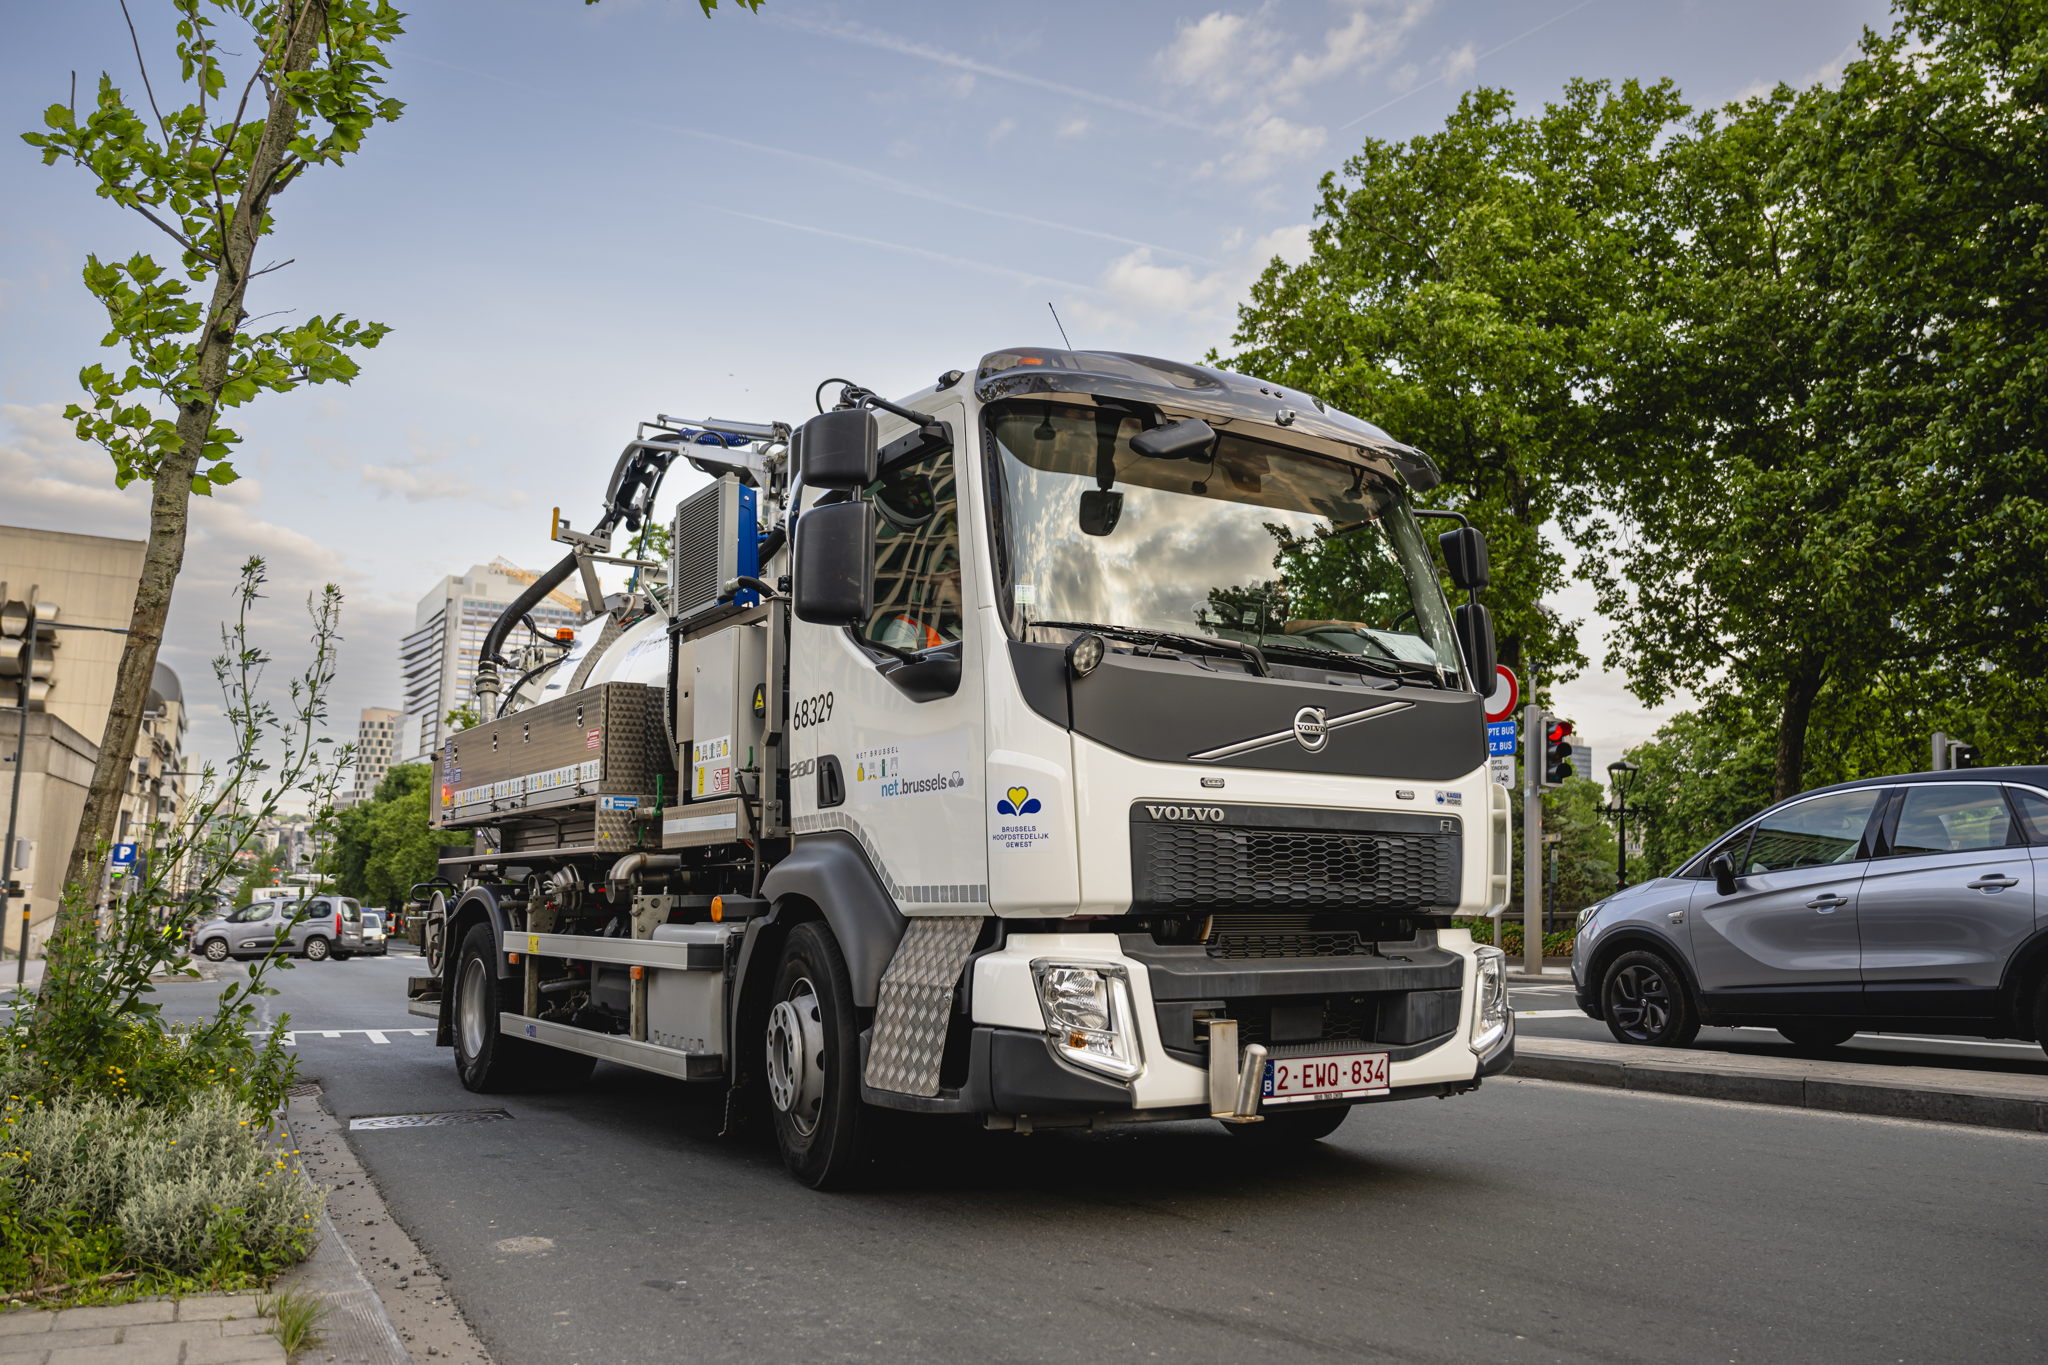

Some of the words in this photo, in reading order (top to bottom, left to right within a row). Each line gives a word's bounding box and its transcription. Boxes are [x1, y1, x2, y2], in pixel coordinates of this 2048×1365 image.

[793, 691, 834, 731] 68329
[1296, 724, 1326, 733] VOLVO
[1501, 726, 1515, 736] BUS
[870, 746, 899, 758] BRUSSEL
[1499, 741, 1513, 751] BUS
[790, 758, 816, 780] 280
[881, 773, 948, 797] net.brussels
[1145, 805, 1225, 822] VOLVO
[1001, 825, 1037, 833] BRUSSELS
[1440, 820, 1458, 833] FL
[992, 833, 1049, 841] HOOFDSTEDELIJK
[119, 846, 132, 860] P
[1277, 1059, 1385, 1091] 2-EWQ-834
[1264, 1080, 1273, 1092] B
